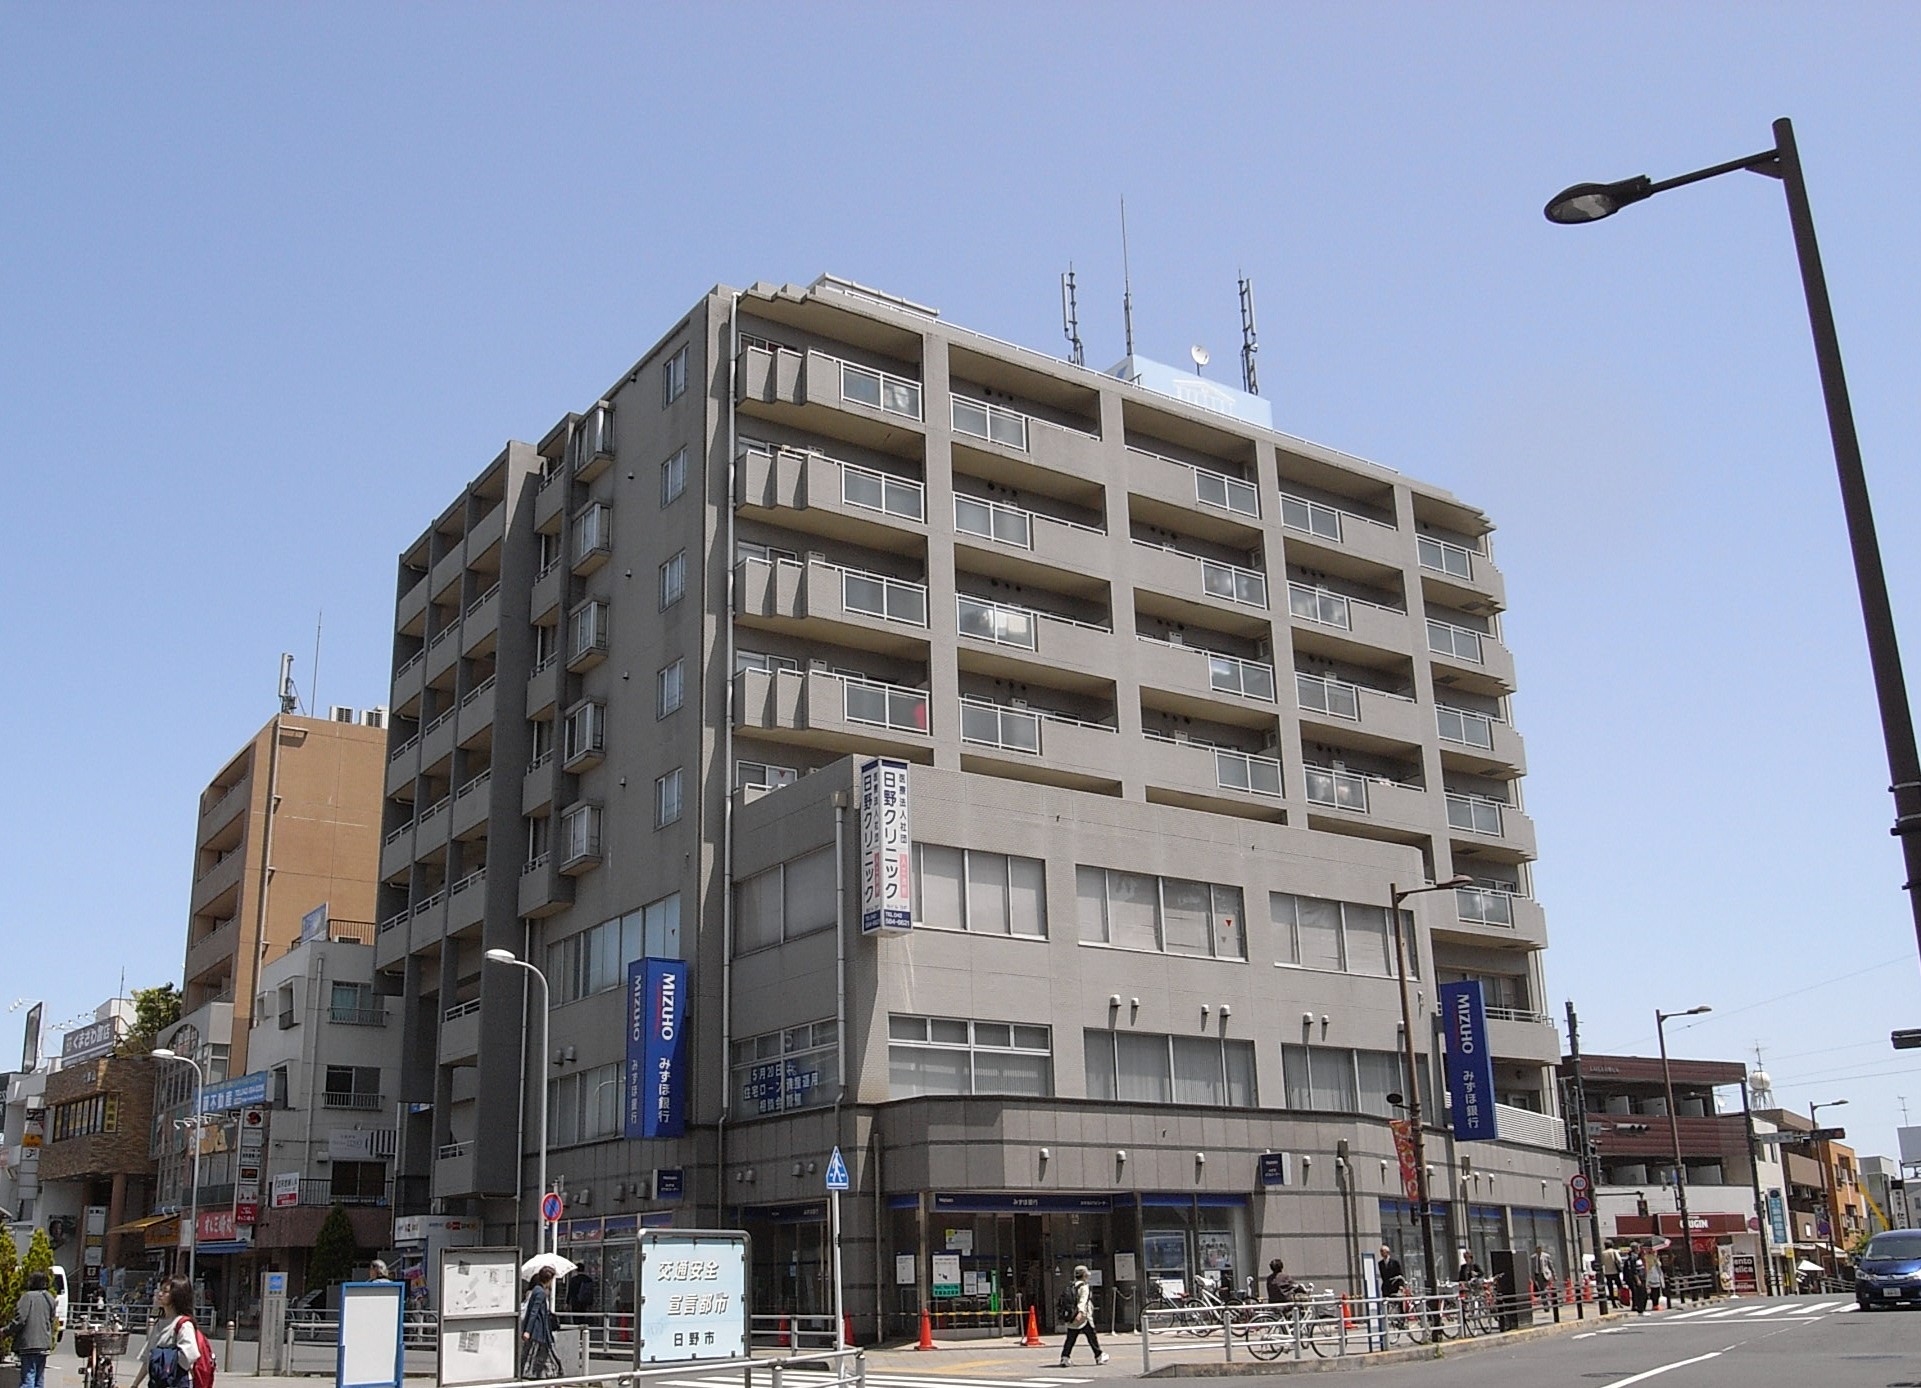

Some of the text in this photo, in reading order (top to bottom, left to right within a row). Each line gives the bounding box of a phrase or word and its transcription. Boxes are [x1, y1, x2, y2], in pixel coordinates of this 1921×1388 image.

[864, 774, 874, 903] 日野クリニック
[883, 771, 898, 899] 日野クリニック
[633, 975, 642, 1042] MIZUHO
[661, 973, 676, 1041] MIZUHO
[1456, 994, 1474, 1054] MIZUHO
[658, 1057, 671, 1123] みずほ銀行
[1463, 1070, 1479, 1129] みずほ銀行
[657, 1261, 719, 1281] 交通安全
[667, 1292, 729, 1316] 宣言都市
[674, 1331, 715, 1347] 日野市
